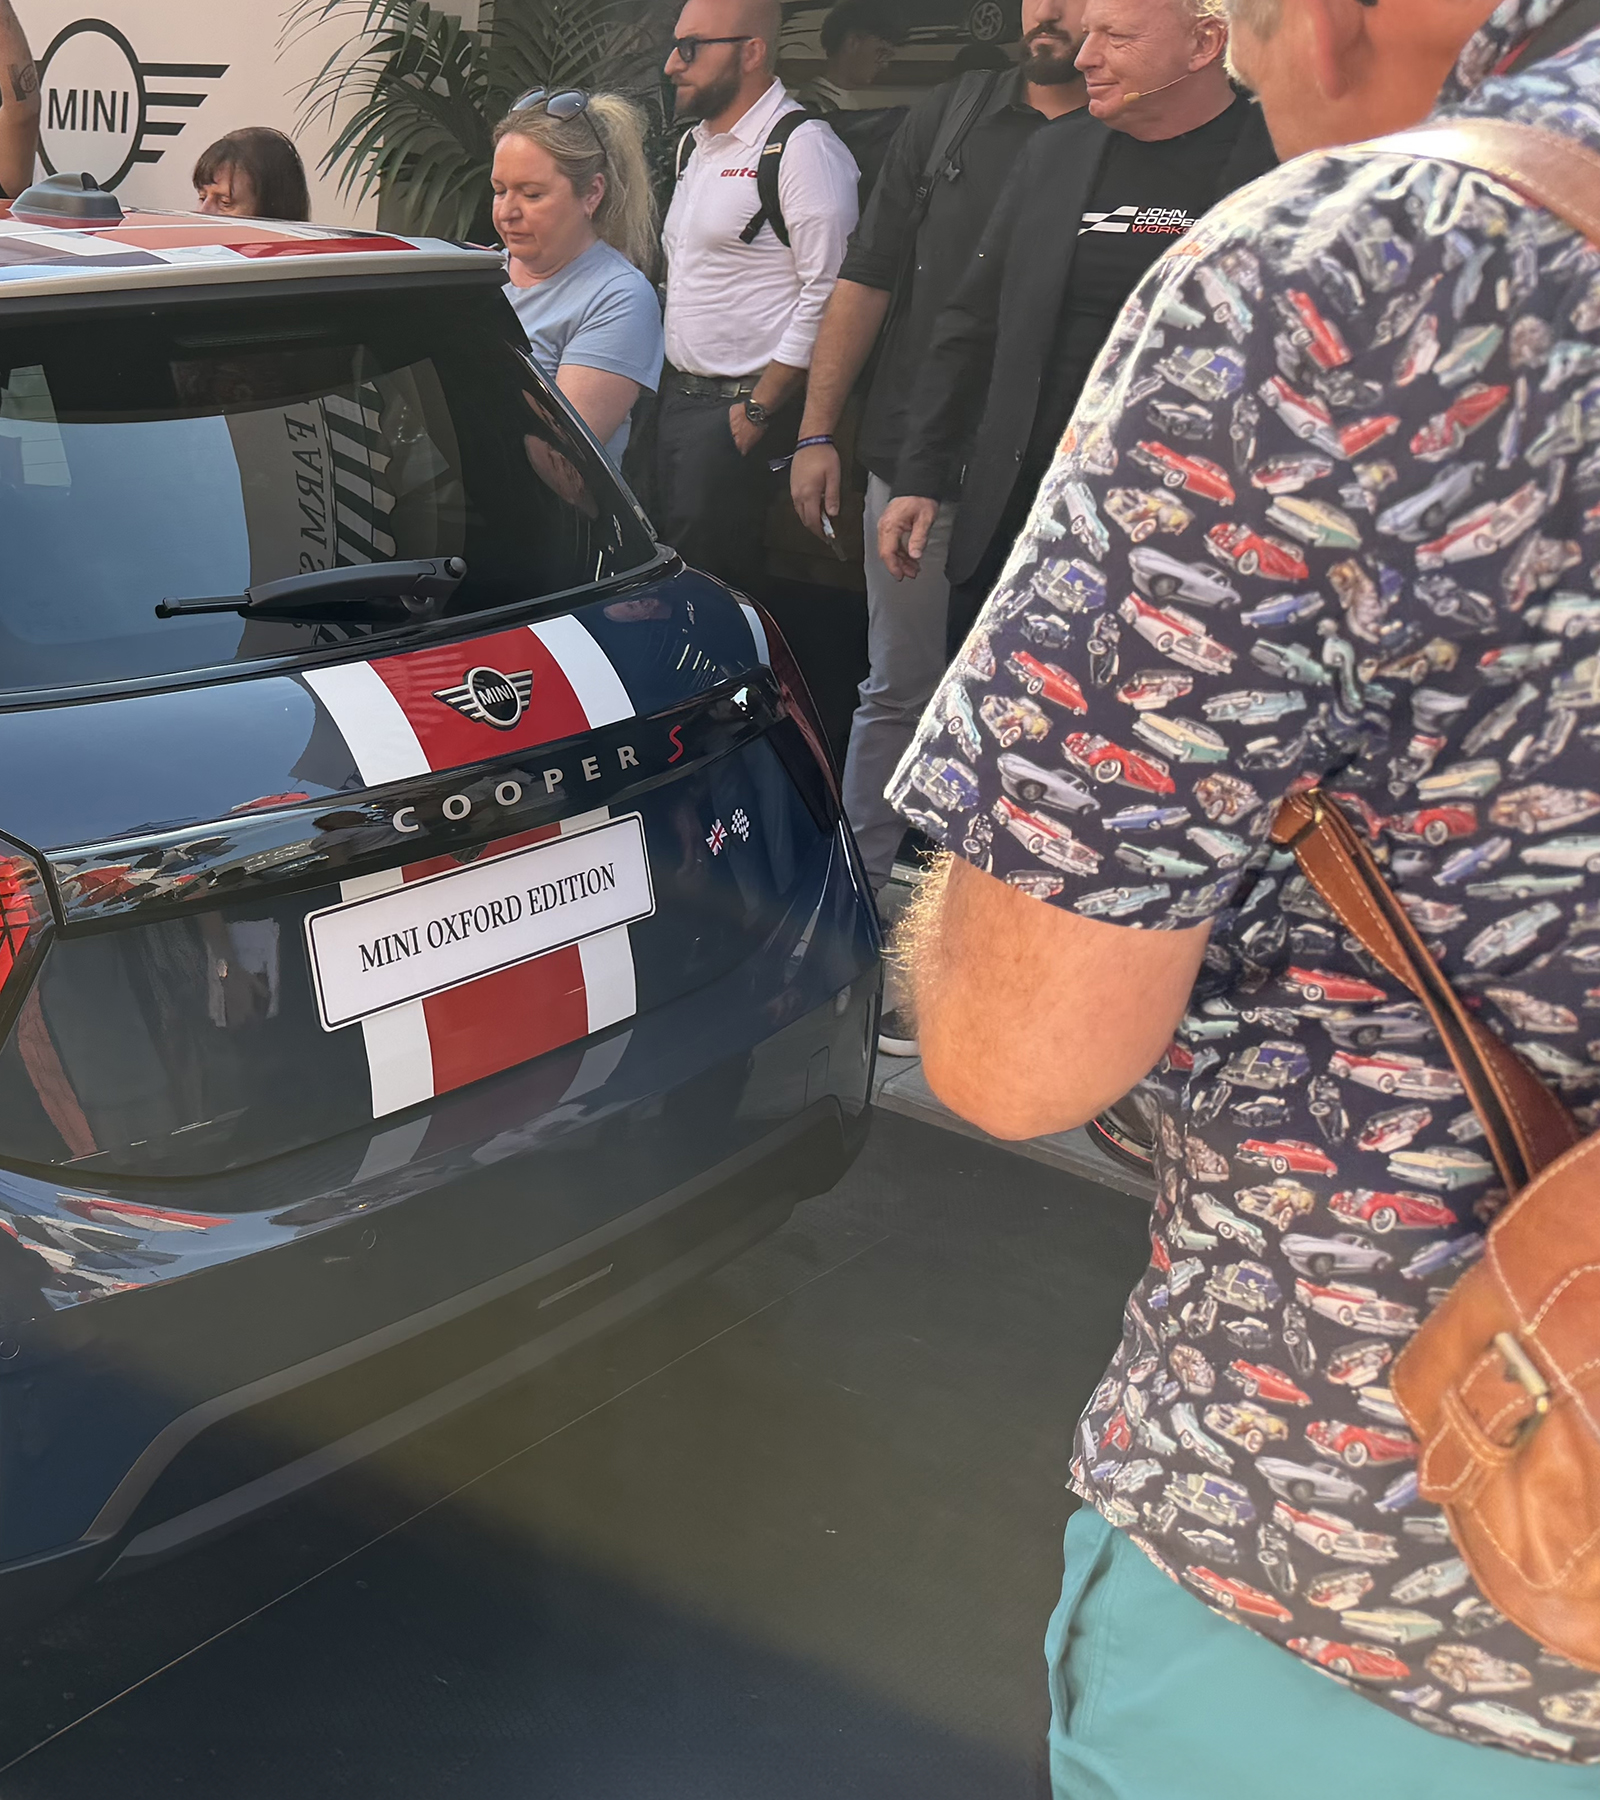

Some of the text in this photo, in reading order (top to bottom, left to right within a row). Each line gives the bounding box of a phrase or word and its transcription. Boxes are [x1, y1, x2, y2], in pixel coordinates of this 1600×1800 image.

[48, 87, 129, 134] MINI
[1138, 207, 1187, 218] JOHN
[477, 684, 515, 706] MINI
[392, 725, 684, 833] COOPER S
[358, 862, 618, 973] MINI OXFORD EDITION
